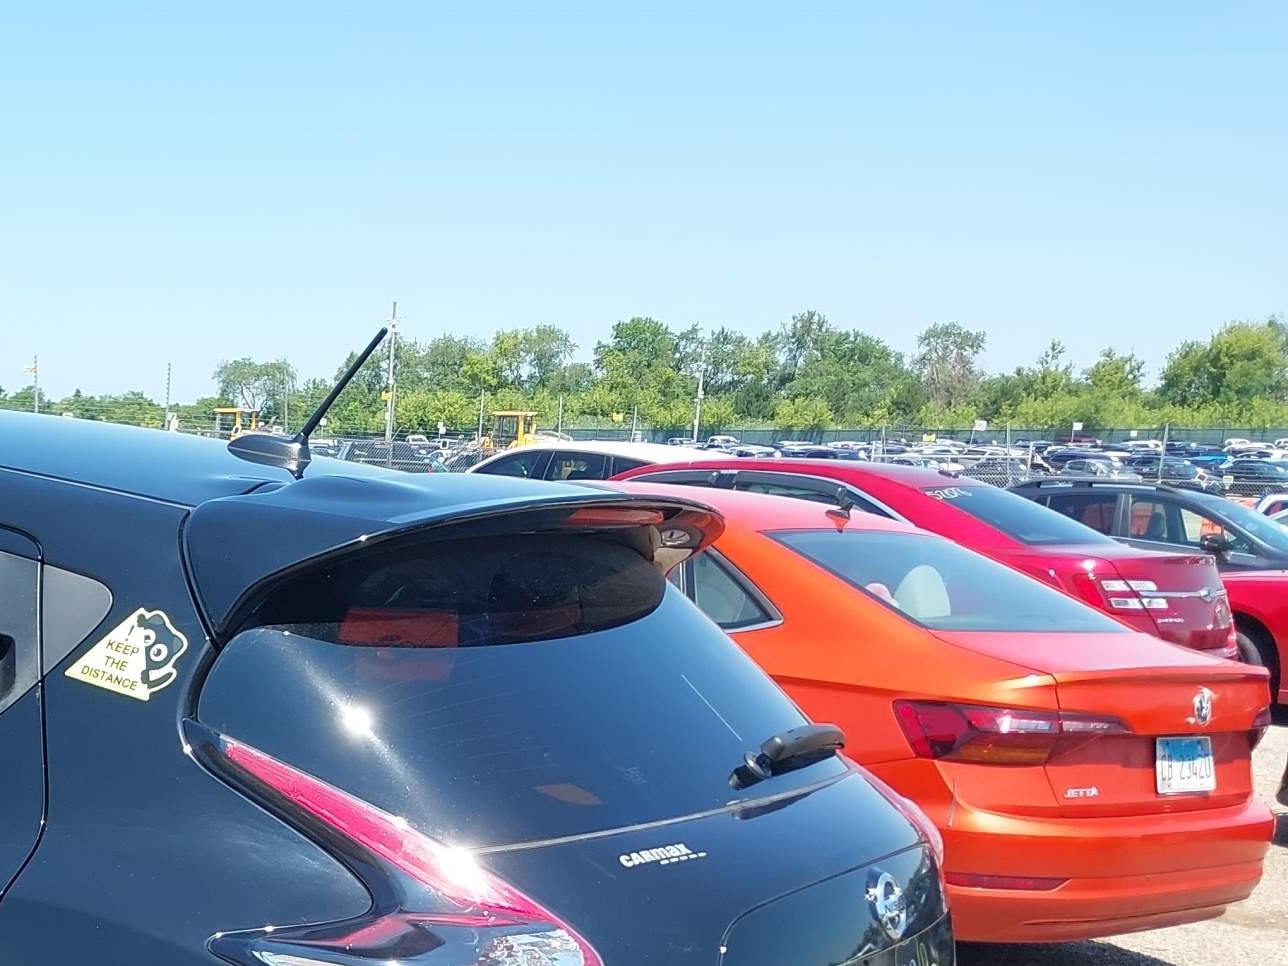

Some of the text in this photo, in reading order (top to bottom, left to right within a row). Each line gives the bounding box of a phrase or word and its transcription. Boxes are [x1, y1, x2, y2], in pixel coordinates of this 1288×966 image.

[106, 639, 140, 657] KEEP
[104, 655, 129, 672] THE
[81, 665, 139, 691] DISTANCE
[1064, 786, 1099, 799] JETTA
